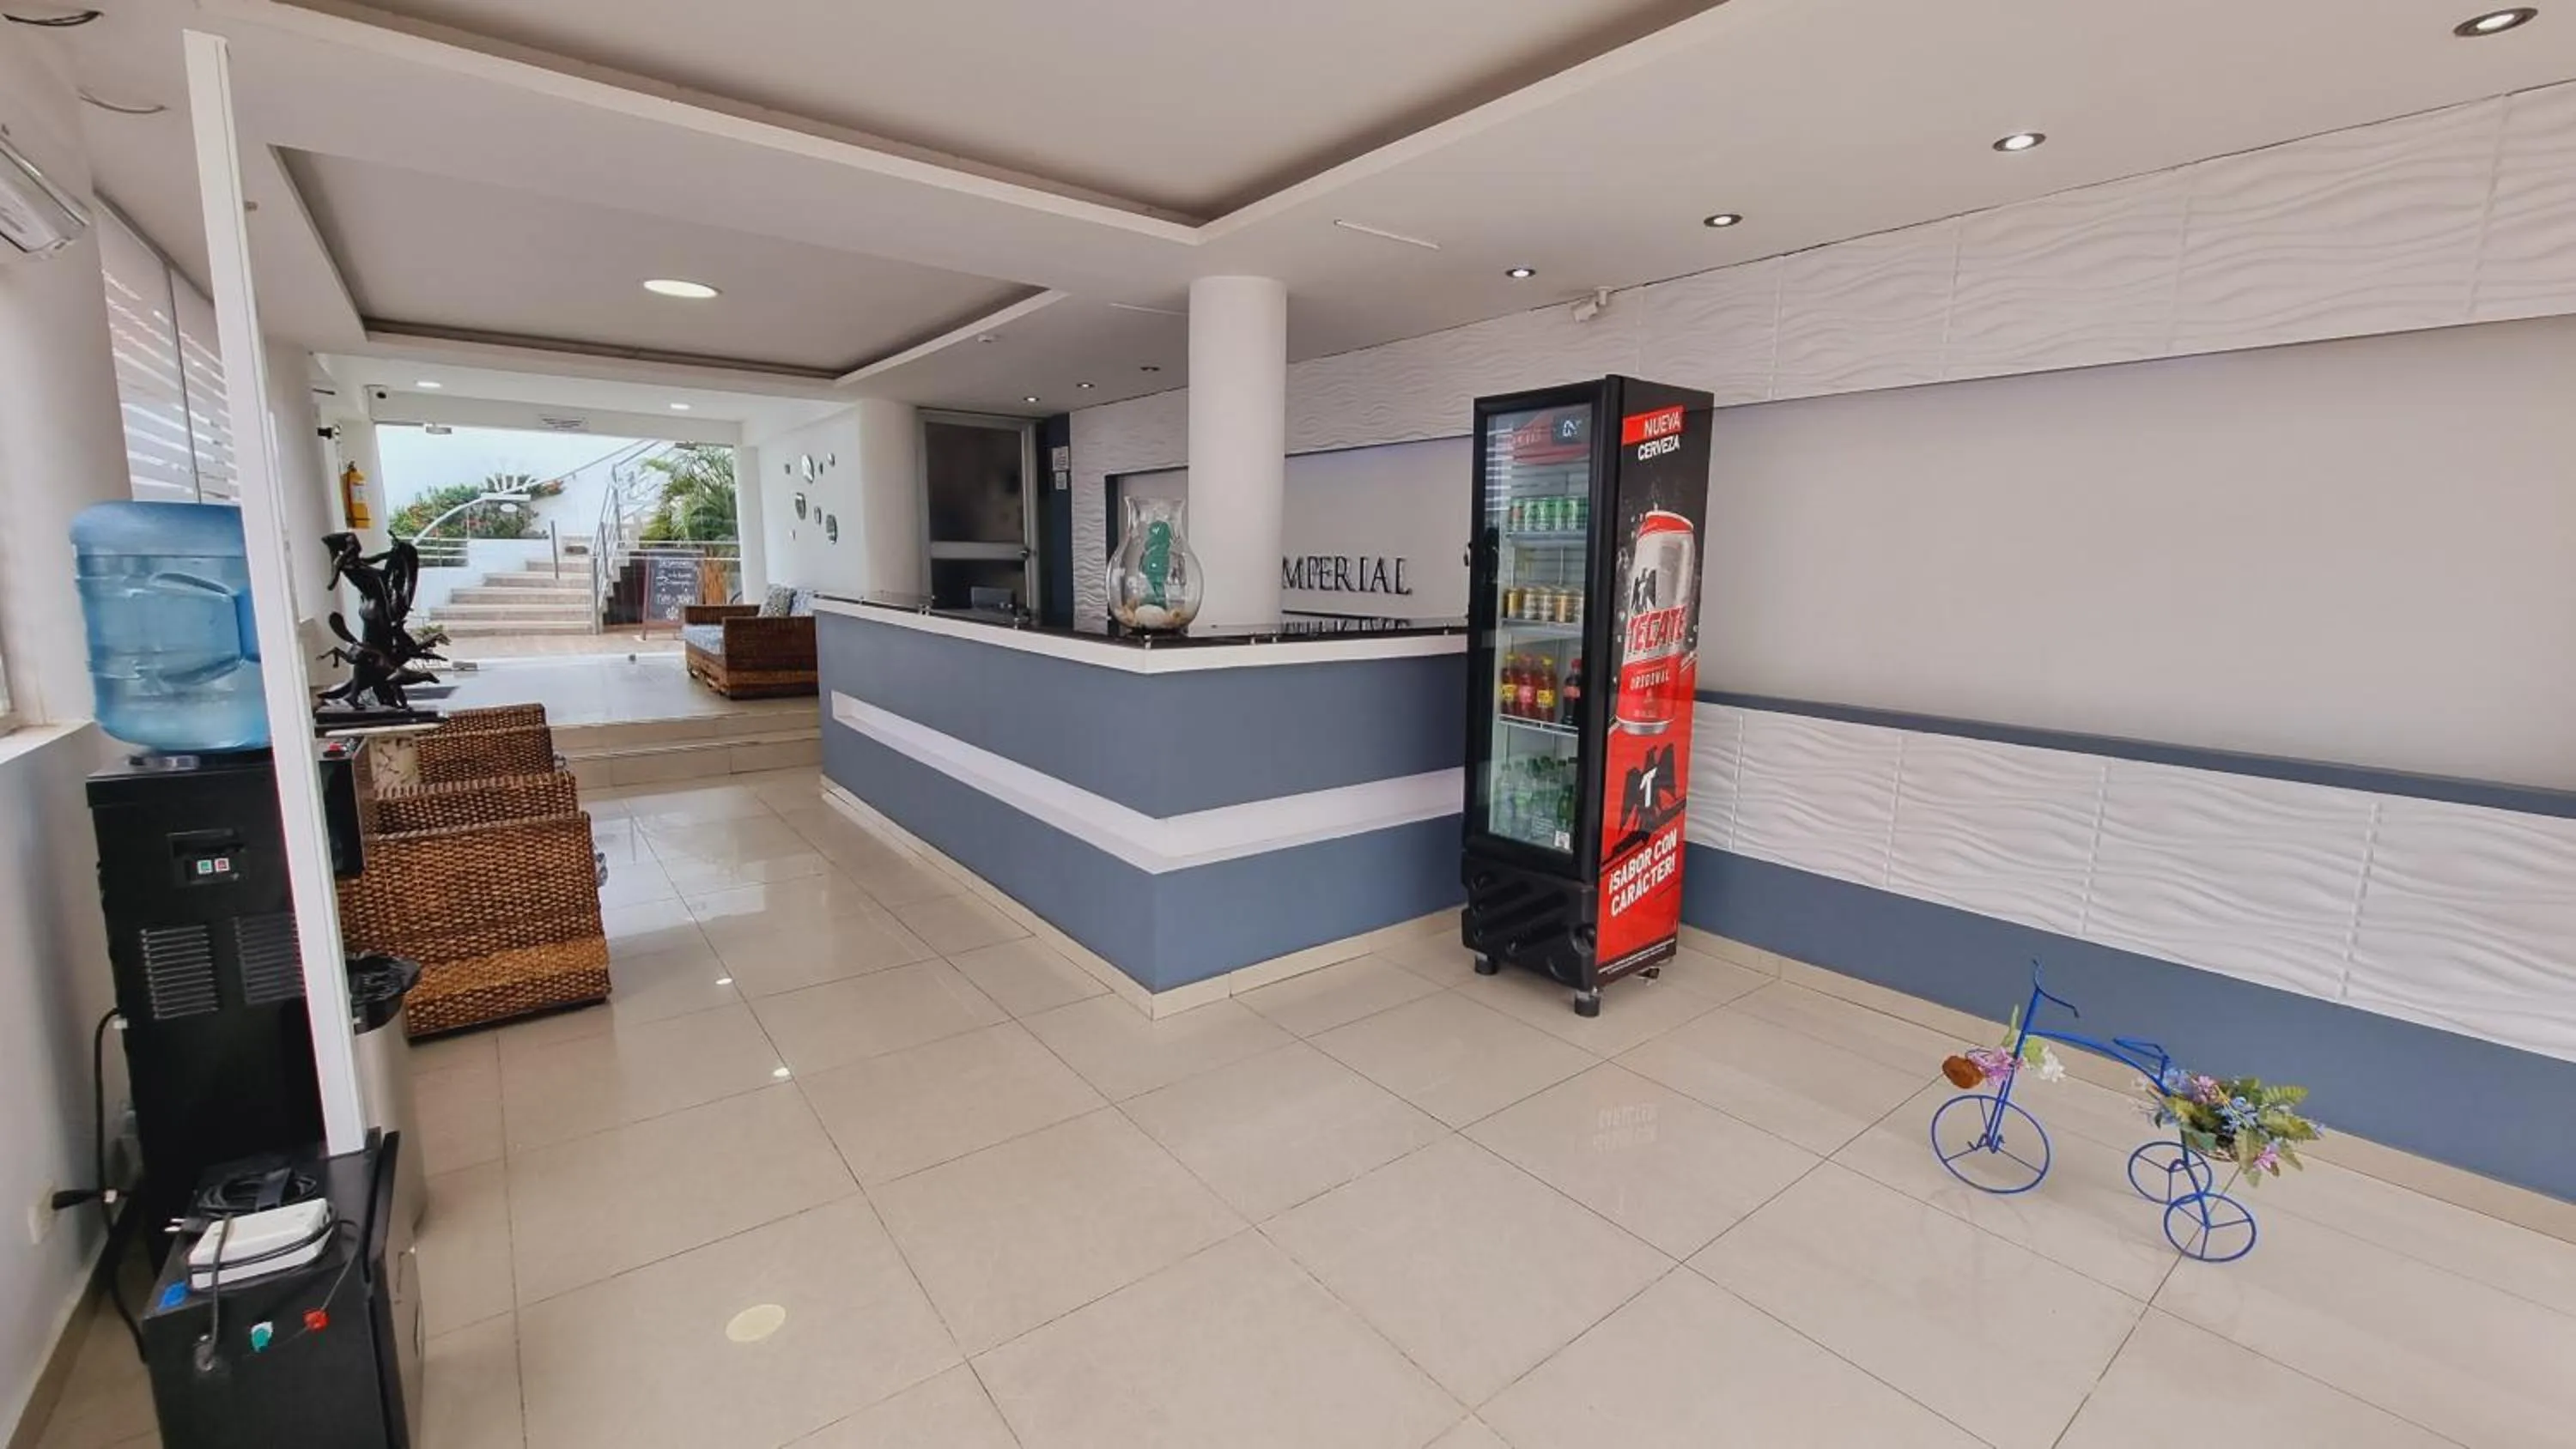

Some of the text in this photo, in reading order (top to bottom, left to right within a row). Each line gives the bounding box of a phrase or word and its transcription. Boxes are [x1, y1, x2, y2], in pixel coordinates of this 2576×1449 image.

[1644, 411, 1681, 438] NUEVA
[1637, 433, 1680, 461] CERVEZA
[1282, 555, 1413, 595] MPERIAL
[1627, 605, 1686, 652] TECATE
[1630, 670, 1670, 691] ORIGINAL
[1608, 827, 1677, 895] ¡SABOR CON
